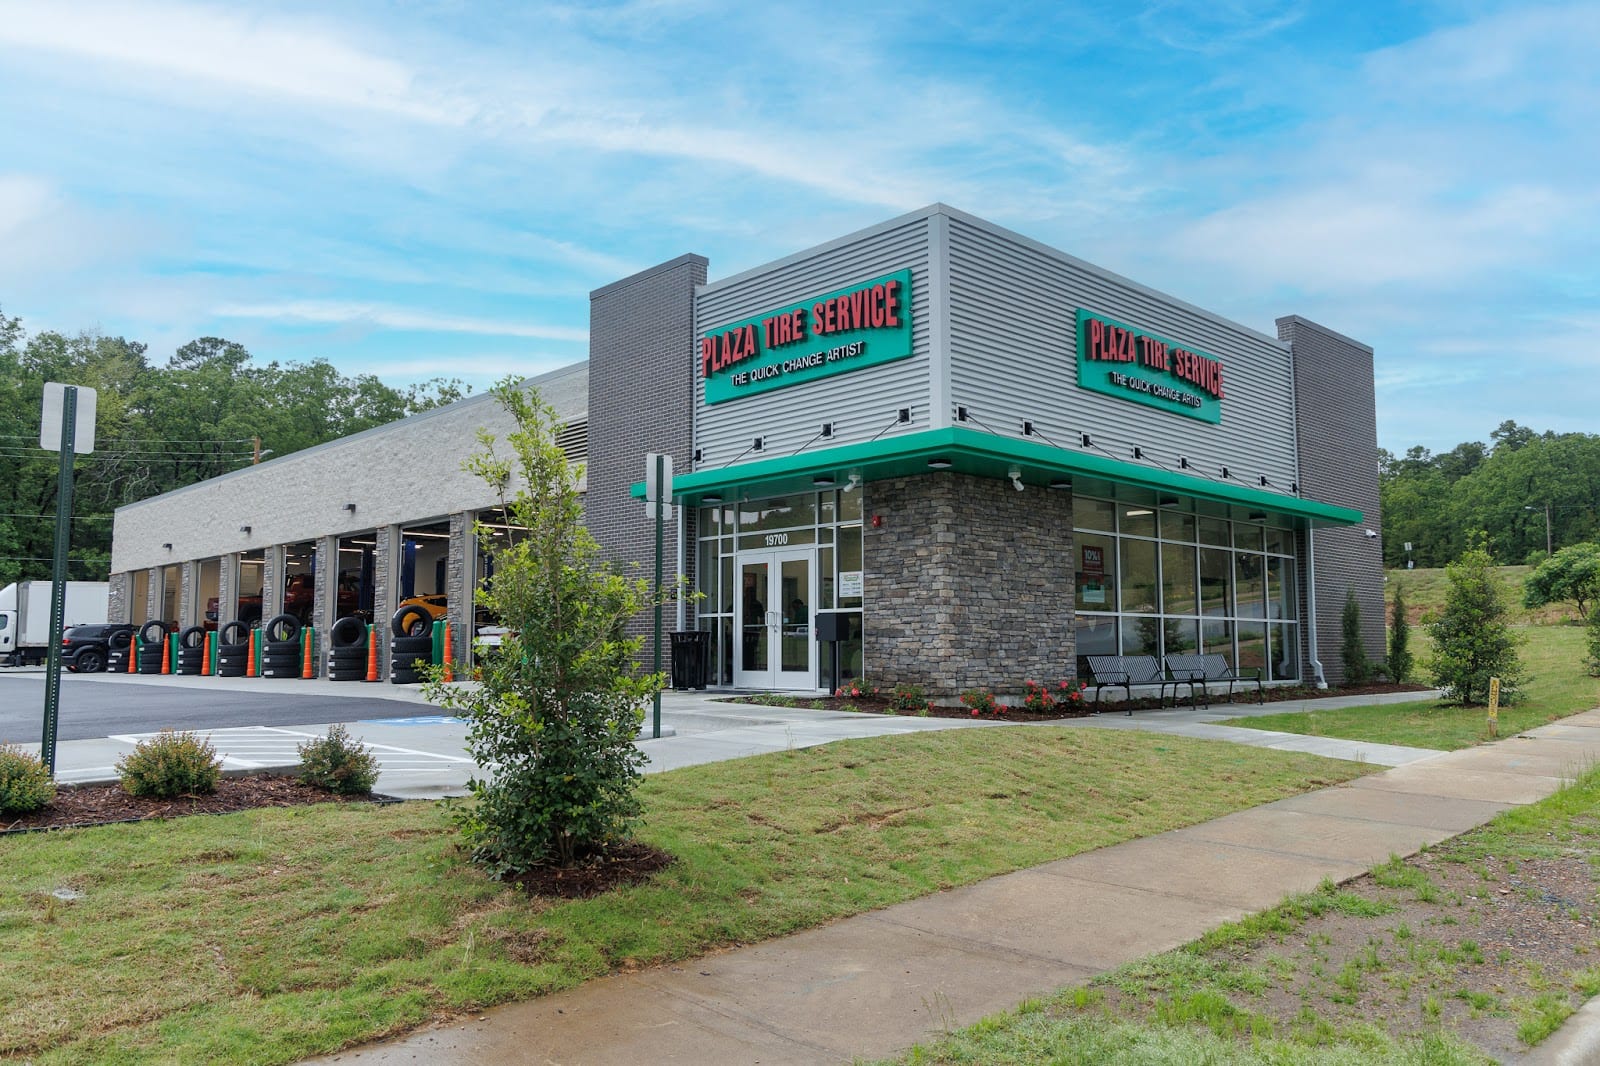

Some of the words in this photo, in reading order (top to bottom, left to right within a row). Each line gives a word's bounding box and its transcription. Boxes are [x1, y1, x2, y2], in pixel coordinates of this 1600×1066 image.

[702, 324, 755, 376] PLAZA
[762, 309, 803, 349] TIRE
[812, 280, 898, 335] SERVICE
[731, 372, 747, 385] THE
[750, 364, 779, 381] QUICK
[782, 352, 823, 373] CHANGE
[826, 341, 863, 361] ARTIST
[1091, 319, 1136, 362] PLAZA
[1141, 335, 1171, 371] TIRE
[1175, 348, 1225, 399] SERVICE
[1112, 371, 1127, 385] THE
[1129, 376, 1151, 392] QUICK
[1153, 383, 1180, 401] CHANGE
[765, 533, 788, 546] 19700
